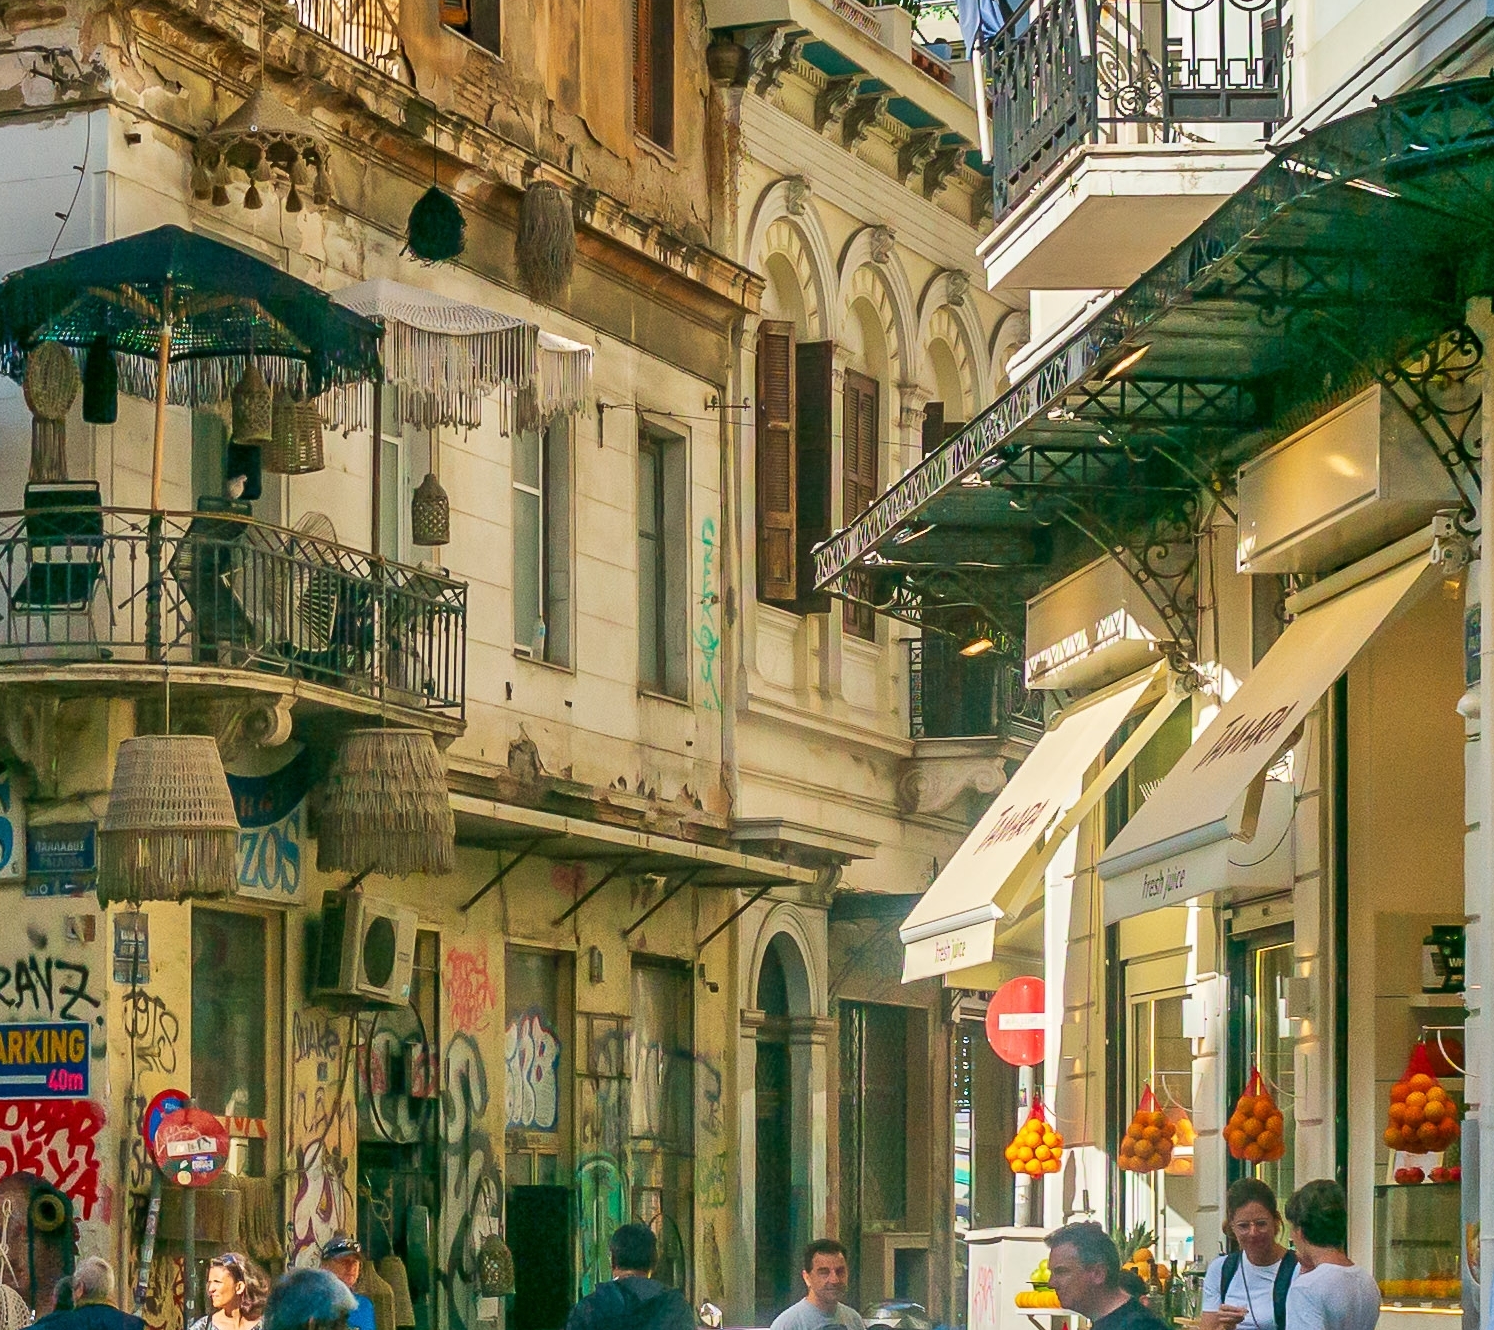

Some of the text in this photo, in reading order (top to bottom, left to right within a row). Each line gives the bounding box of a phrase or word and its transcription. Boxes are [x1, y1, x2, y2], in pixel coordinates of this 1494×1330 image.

[239, 807, 301, 895] ZOS
[1163, 865, 1186, 900] juice
[46, 1068, 85, 1092] 40m
